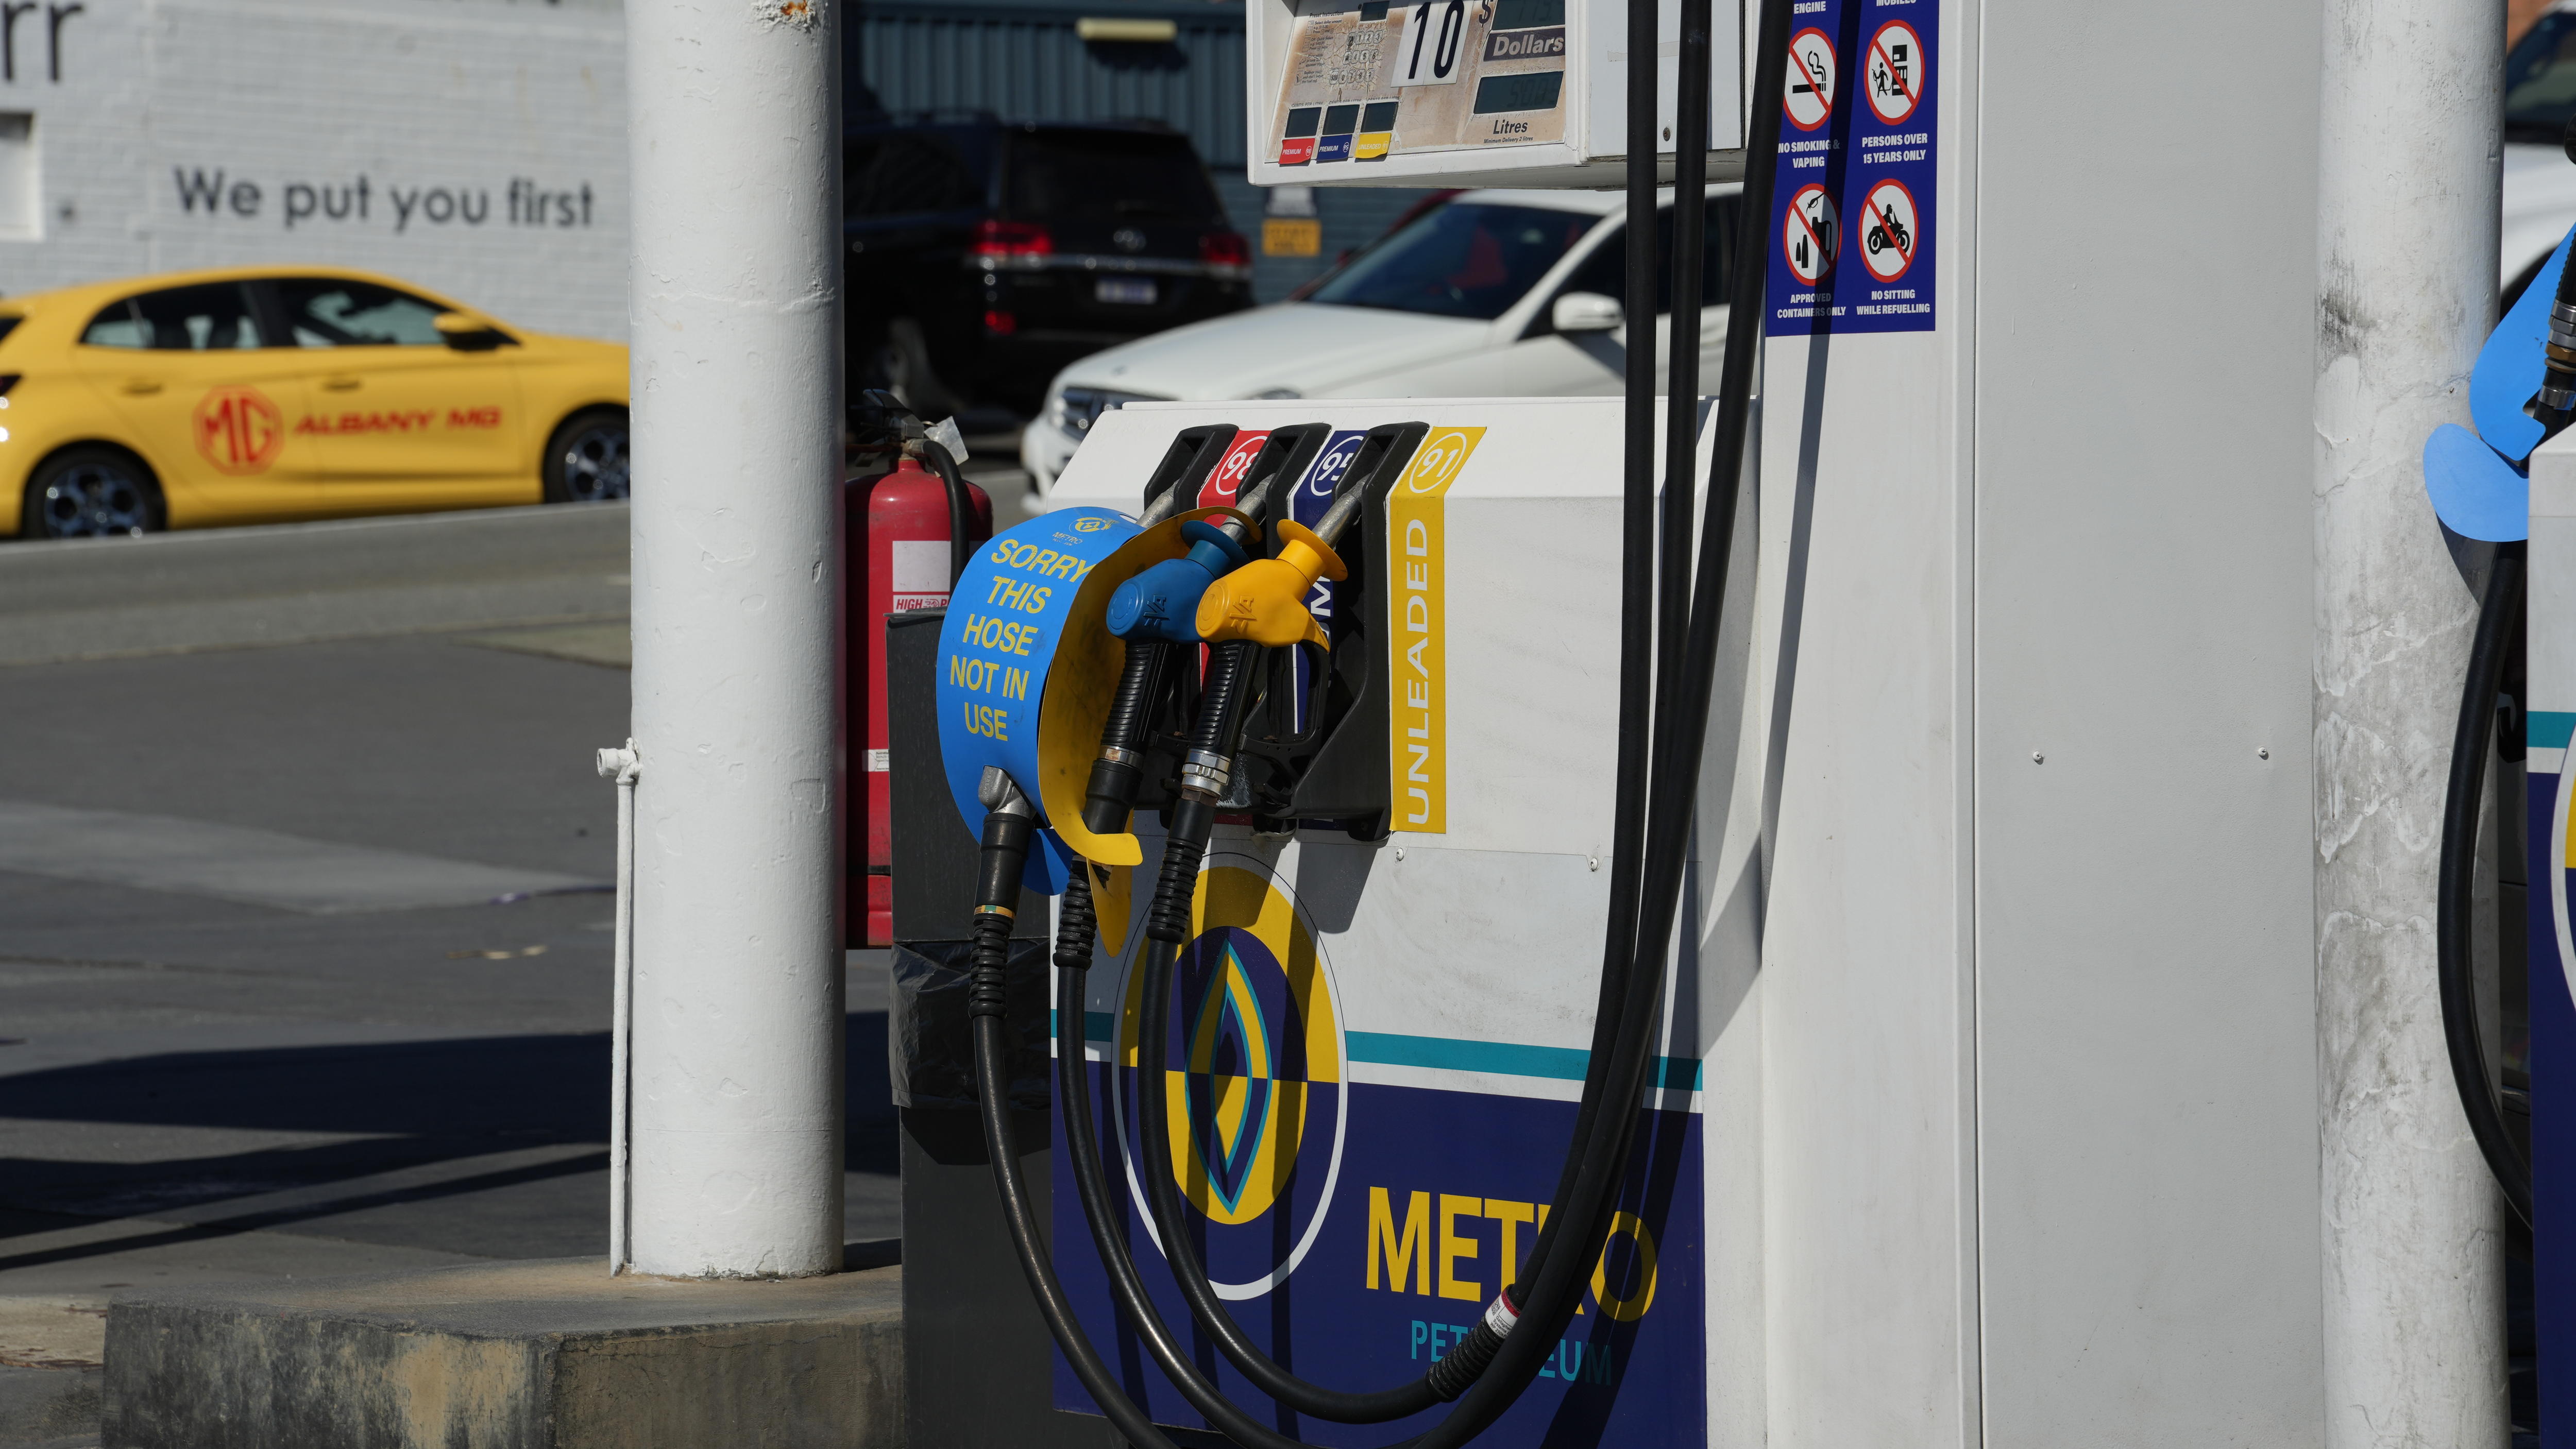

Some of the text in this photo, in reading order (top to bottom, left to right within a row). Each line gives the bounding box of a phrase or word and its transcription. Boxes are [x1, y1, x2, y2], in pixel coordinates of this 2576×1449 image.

[1793, 1, 1826, 14] ENGINE
[1408, 0, 1465, 79] 10
[1493, 35, 1564, 56] Dollars
[1493, 119, 1528, 134] Litres
[1778, 139, 1840, 153] NO SMOKING &
[1862, 133, 1928, 147] PERSONS OVER
[1792, 156, 1825, 168] VAPING
[1863, 149, 1926, 164] 15 YEARS ONLY
[174, 166, 594, 234] We put you first
[1790, 293, 1832, 304] APPROVED
[1871, 289, 1916, 300] NO SITTING
[1777, 306, 1846, 319] CONTAINERS ONLY
[1856, 303, 1930, 315] WHILE REFUELLING
[292, 406, 502, 436] ALBANY MG
[1417, 449, 1459, 478] 91
[991, 539, 1096, 583] SORRY
[896, 599, 923, 610] HIGH
[987, 575, 1052, 614] THIS
[962, 613, 1039, 656] HOSE
[950, 655, 1029, 701] NOT IN
[1406, 519, 1429, 824] UNLEADED
[964, 702, 1008, 741] USE
[1366, 1186, 1657, 1322] METO
